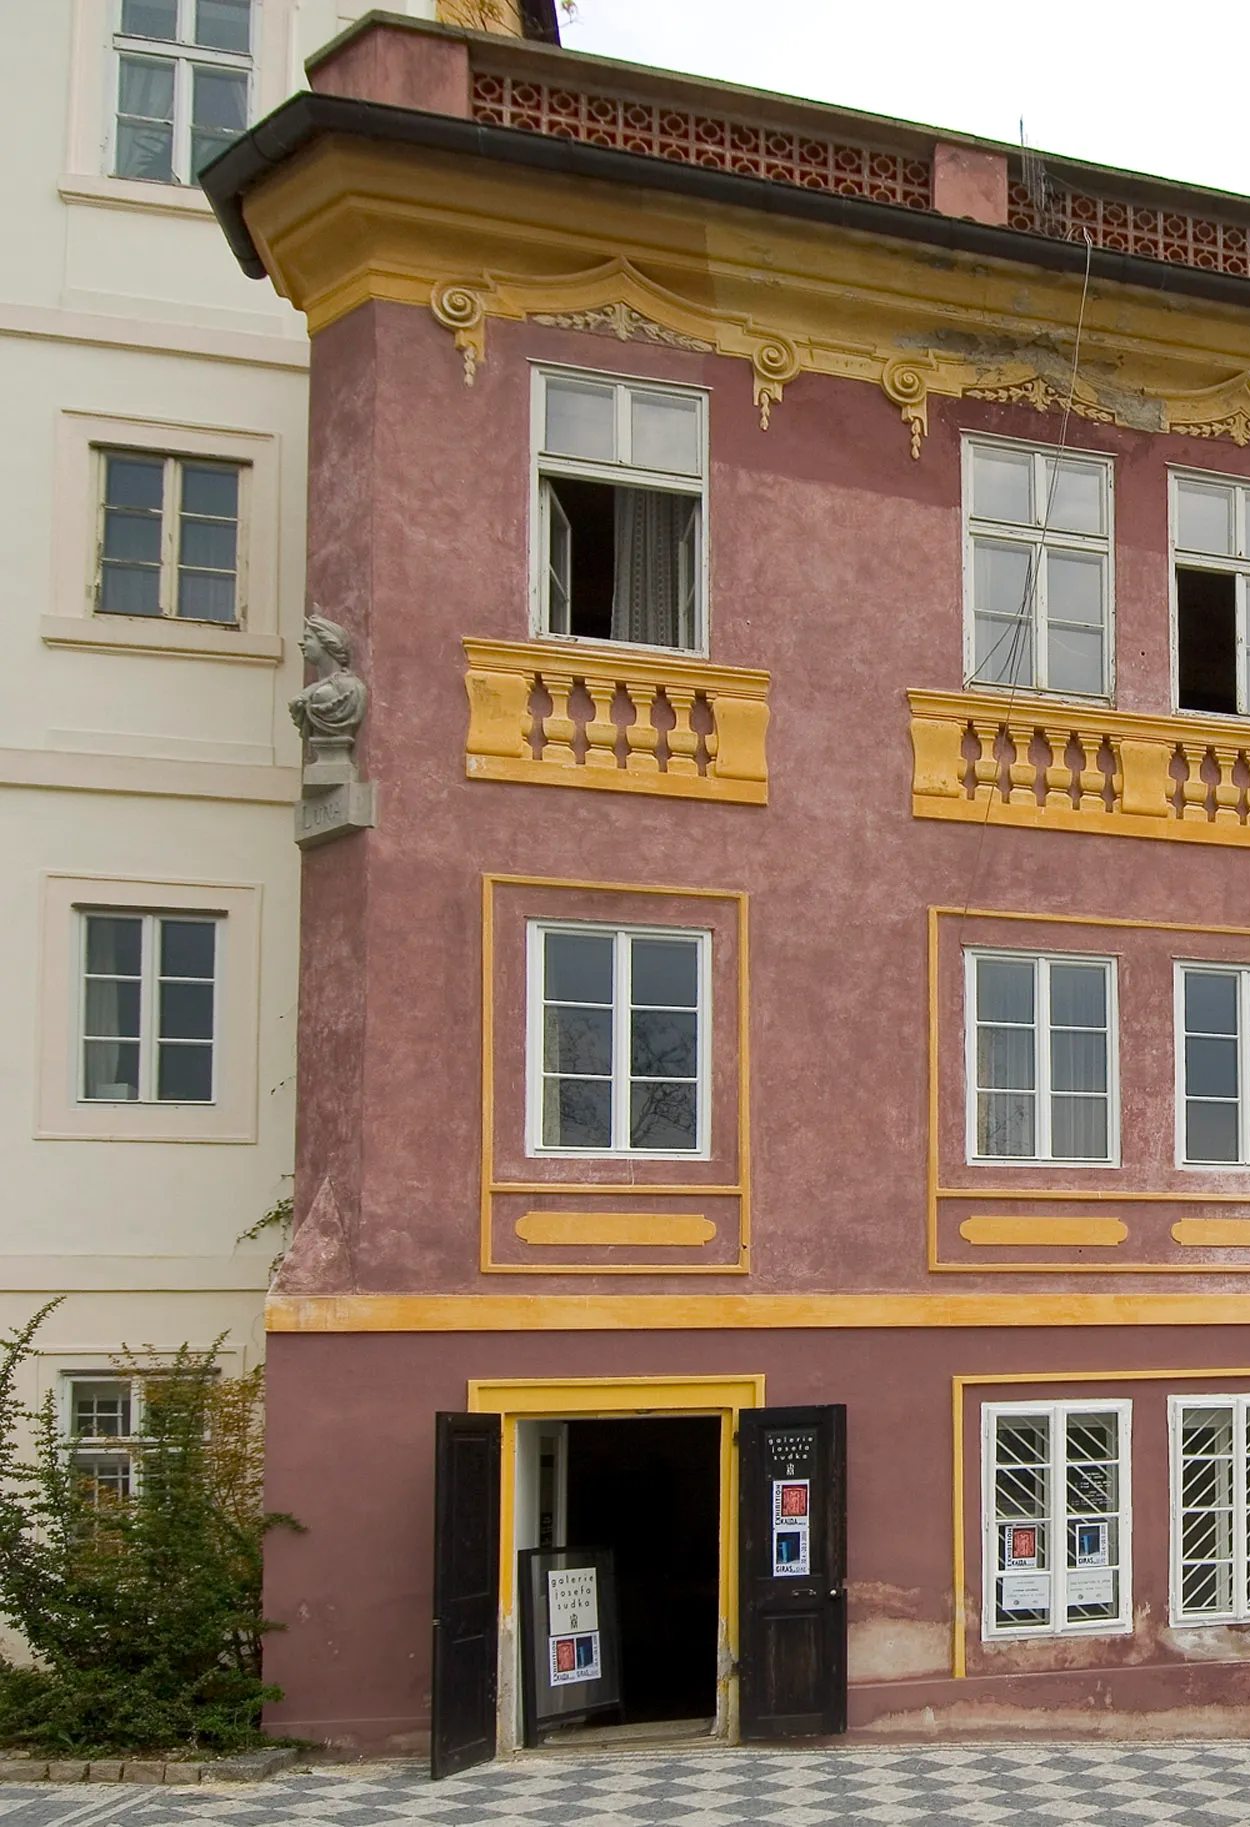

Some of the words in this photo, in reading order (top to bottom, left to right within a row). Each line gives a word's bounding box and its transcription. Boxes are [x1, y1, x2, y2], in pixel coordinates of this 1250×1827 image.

[303, 801, 341, 829] LUNA
[768, 1435, 813, 1446] galerie
[771, 1444, 810, 1454] josefa
[773, 1453, 808, 1461] sudka
[551, 1573, 594, 1588] galerie
[555, 1585, 591, 1600] josefa
[557, 1598, 590, 1611] sudka
